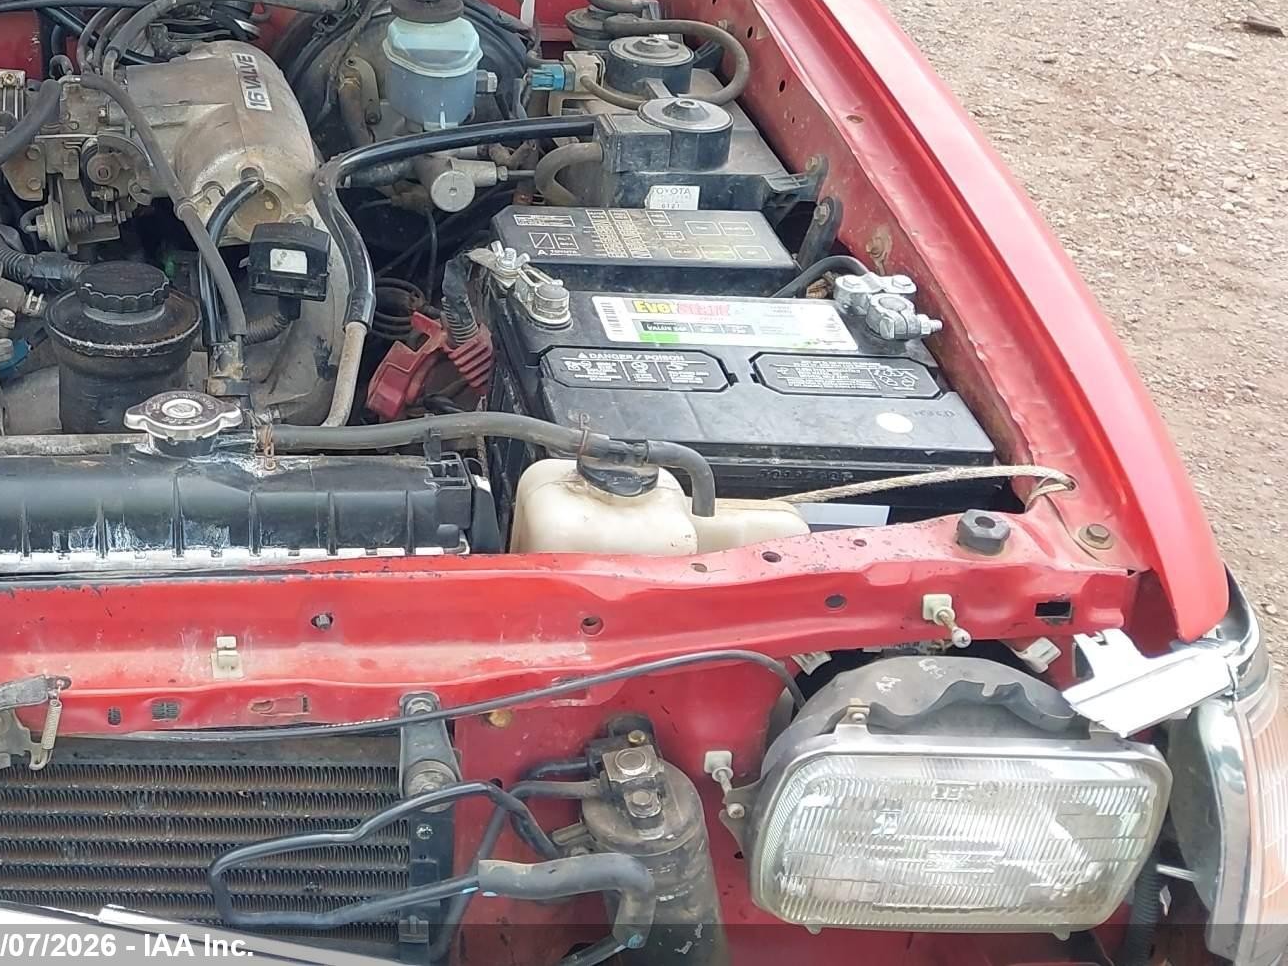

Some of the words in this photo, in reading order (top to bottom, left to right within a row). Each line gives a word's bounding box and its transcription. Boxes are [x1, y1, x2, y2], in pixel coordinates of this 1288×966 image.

[236, 54, 262, 89] VALVE
[247, 91, 267, 106] 16
[652, 187, 691, 195] TOYOTA
[589, 352, 633, 360] DANGER
[645, 354, 685, 362] POISON
